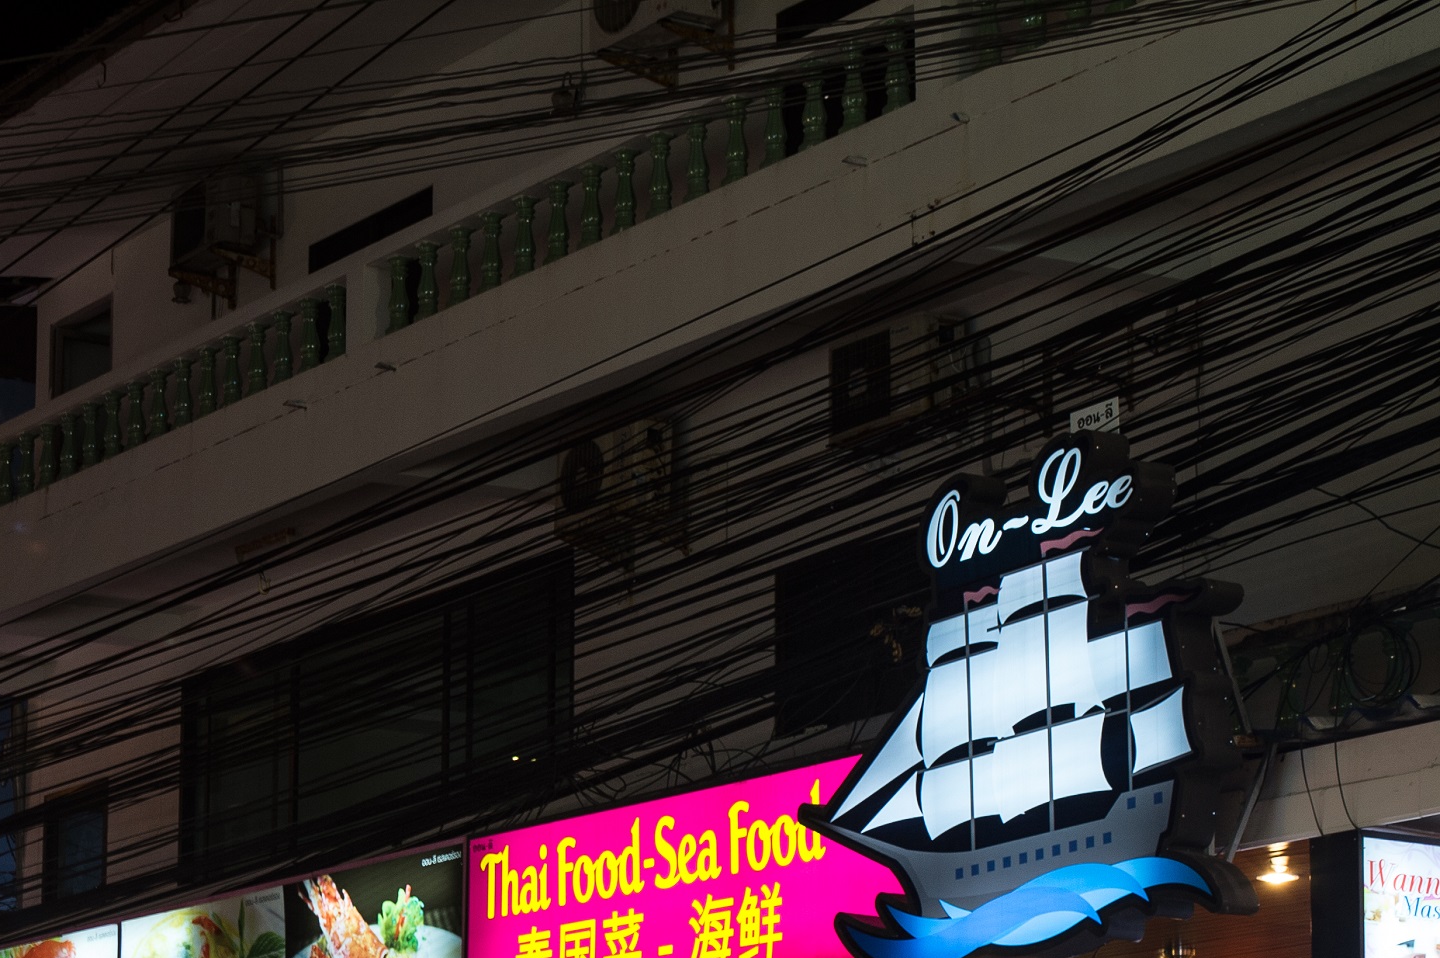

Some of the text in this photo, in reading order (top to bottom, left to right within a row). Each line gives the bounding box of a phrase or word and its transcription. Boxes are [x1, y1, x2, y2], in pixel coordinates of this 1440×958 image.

[1077, 402, 1113, 429] ออน-ลี
[926, 447, 1134, 569] On-Lee
[480, 778, 827, 920] Thai Food-Sea Food
